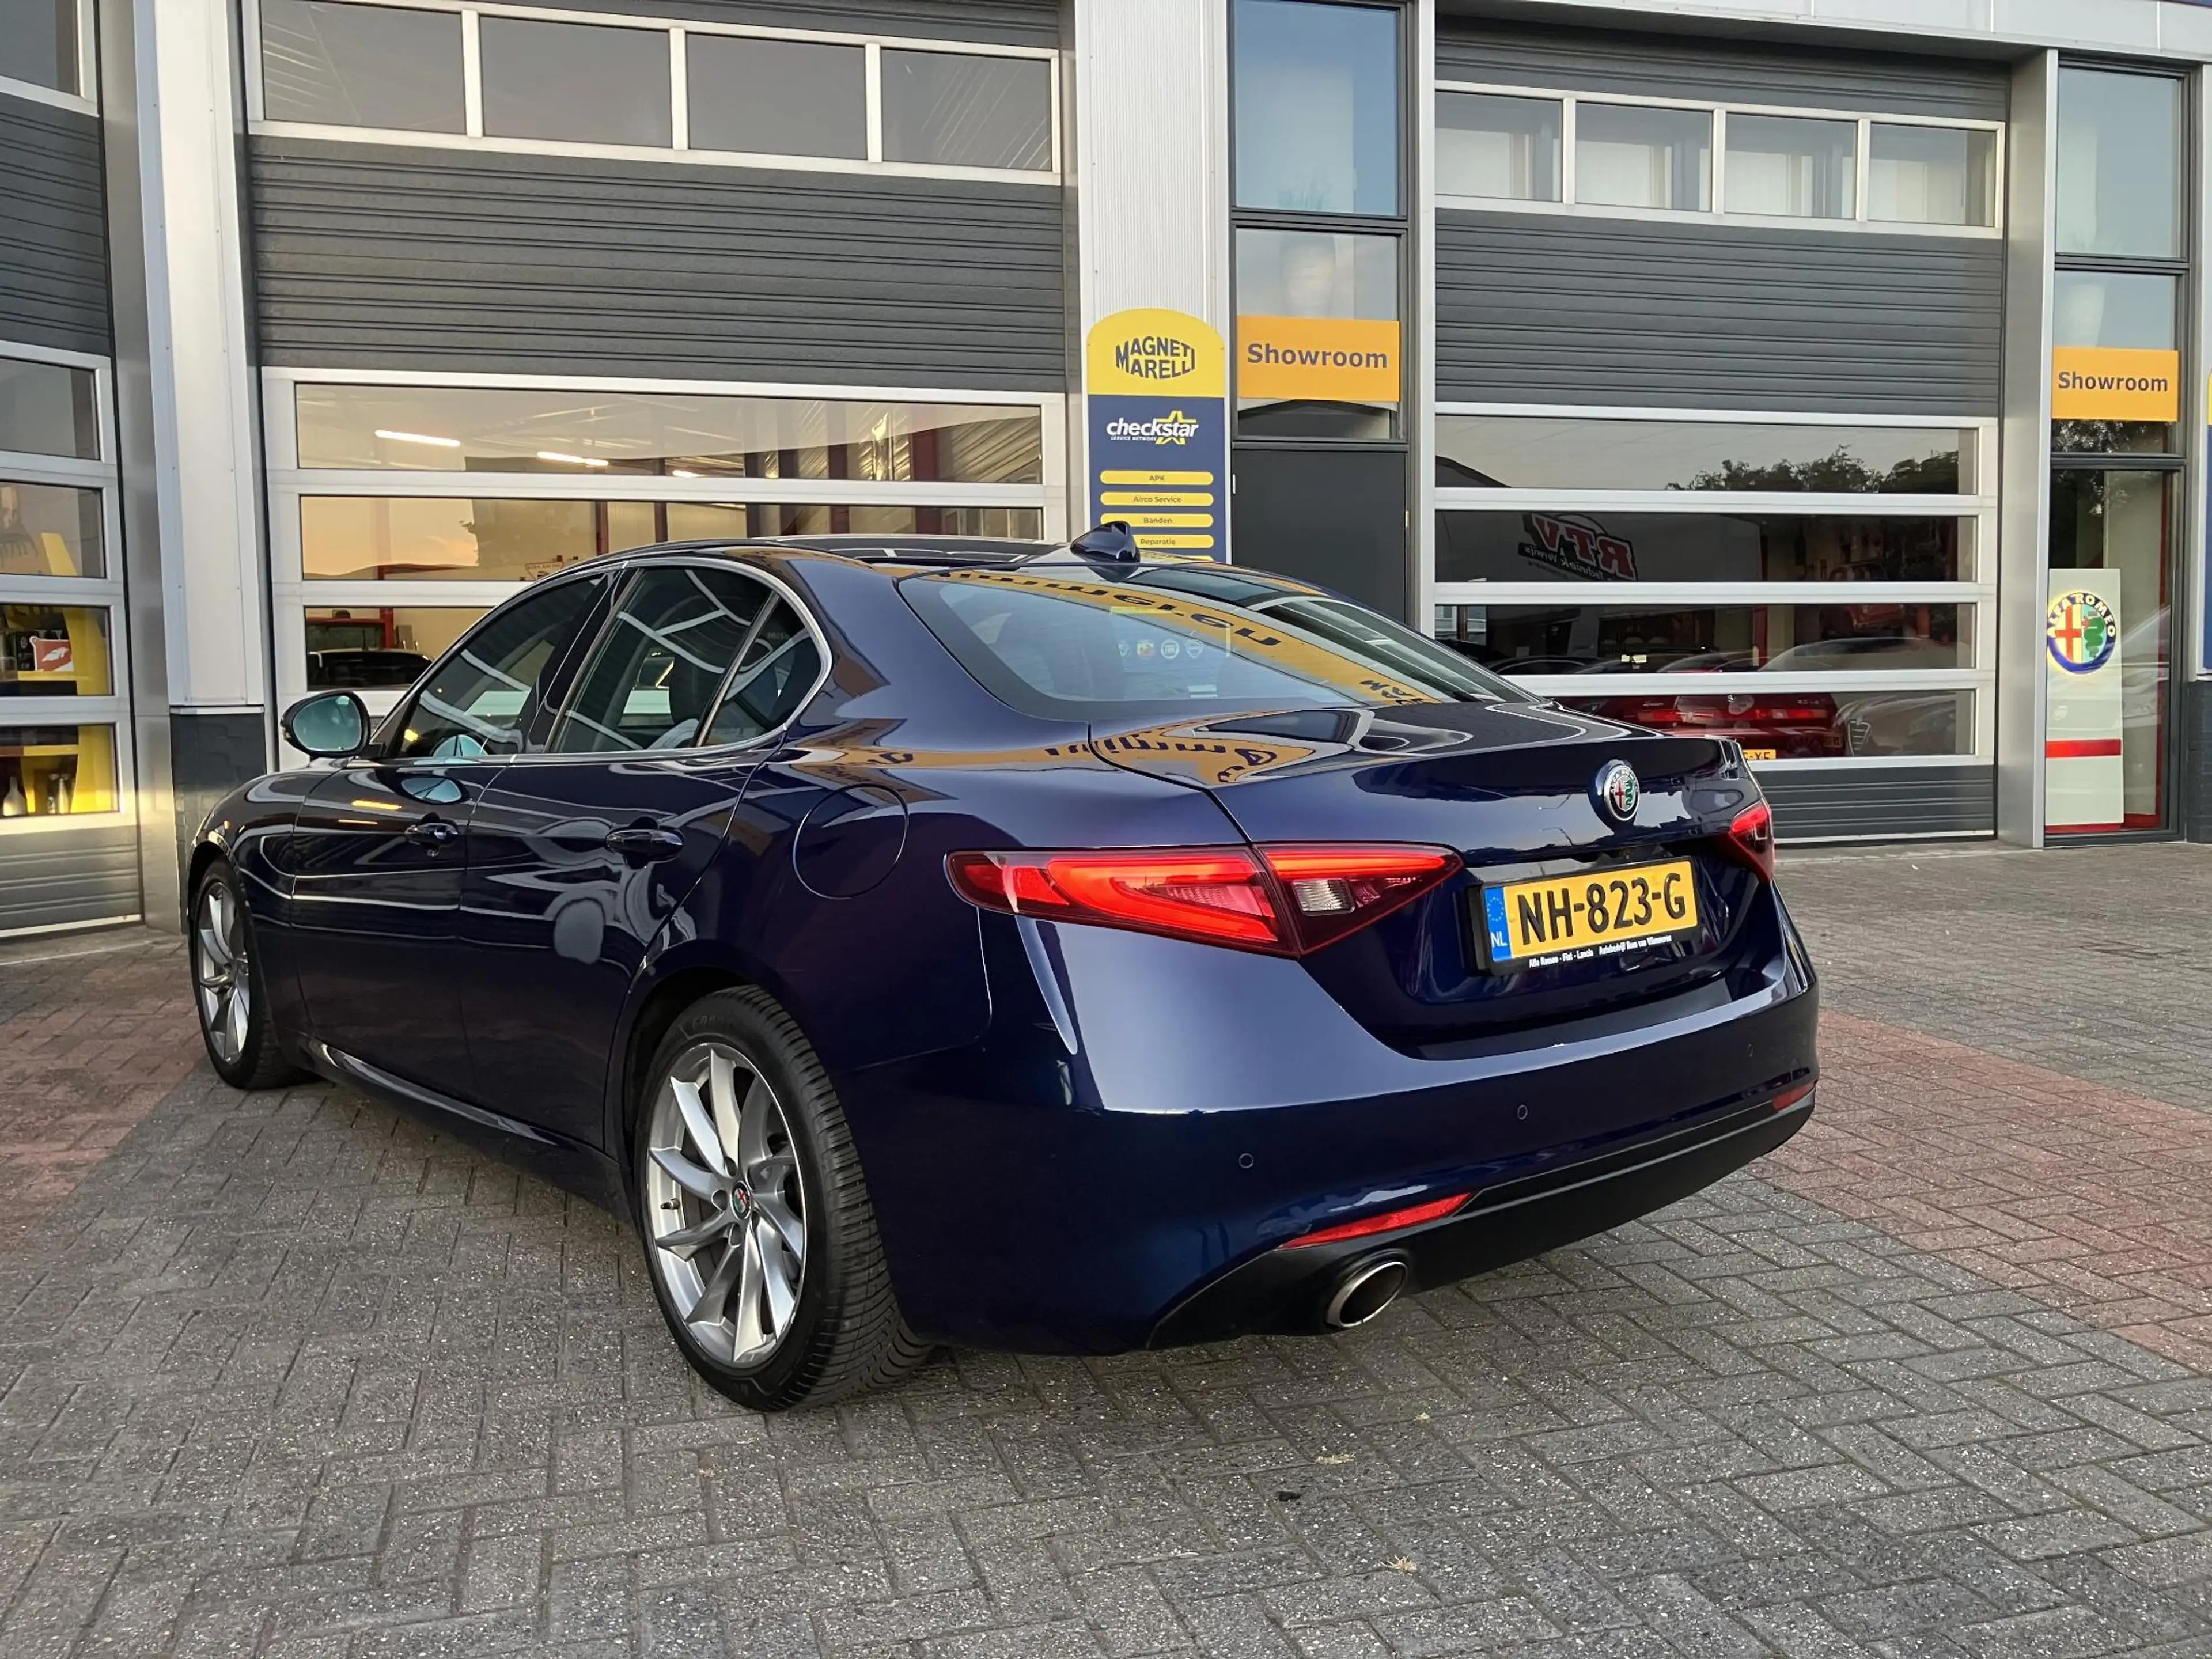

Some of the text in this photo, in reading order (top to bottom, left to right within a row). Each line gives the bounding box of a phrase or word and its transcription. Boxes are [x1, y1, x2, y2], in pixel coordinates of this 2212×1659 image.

[1115, 336, 1195, 363] MAGNETI
[1247, 343, 1388, 369] Showroom
[1115, 355, 1195, 379] MARELLI
[2057, 371, 2169, 393] Showroom
[1106, 417, 1199, 437] checkstar
[2047, 593, 2116, 638] ALFA ROMEO
[1517, 872, 1686, 946] NH-823-G
[1490, 931, 1508, 948] NL
